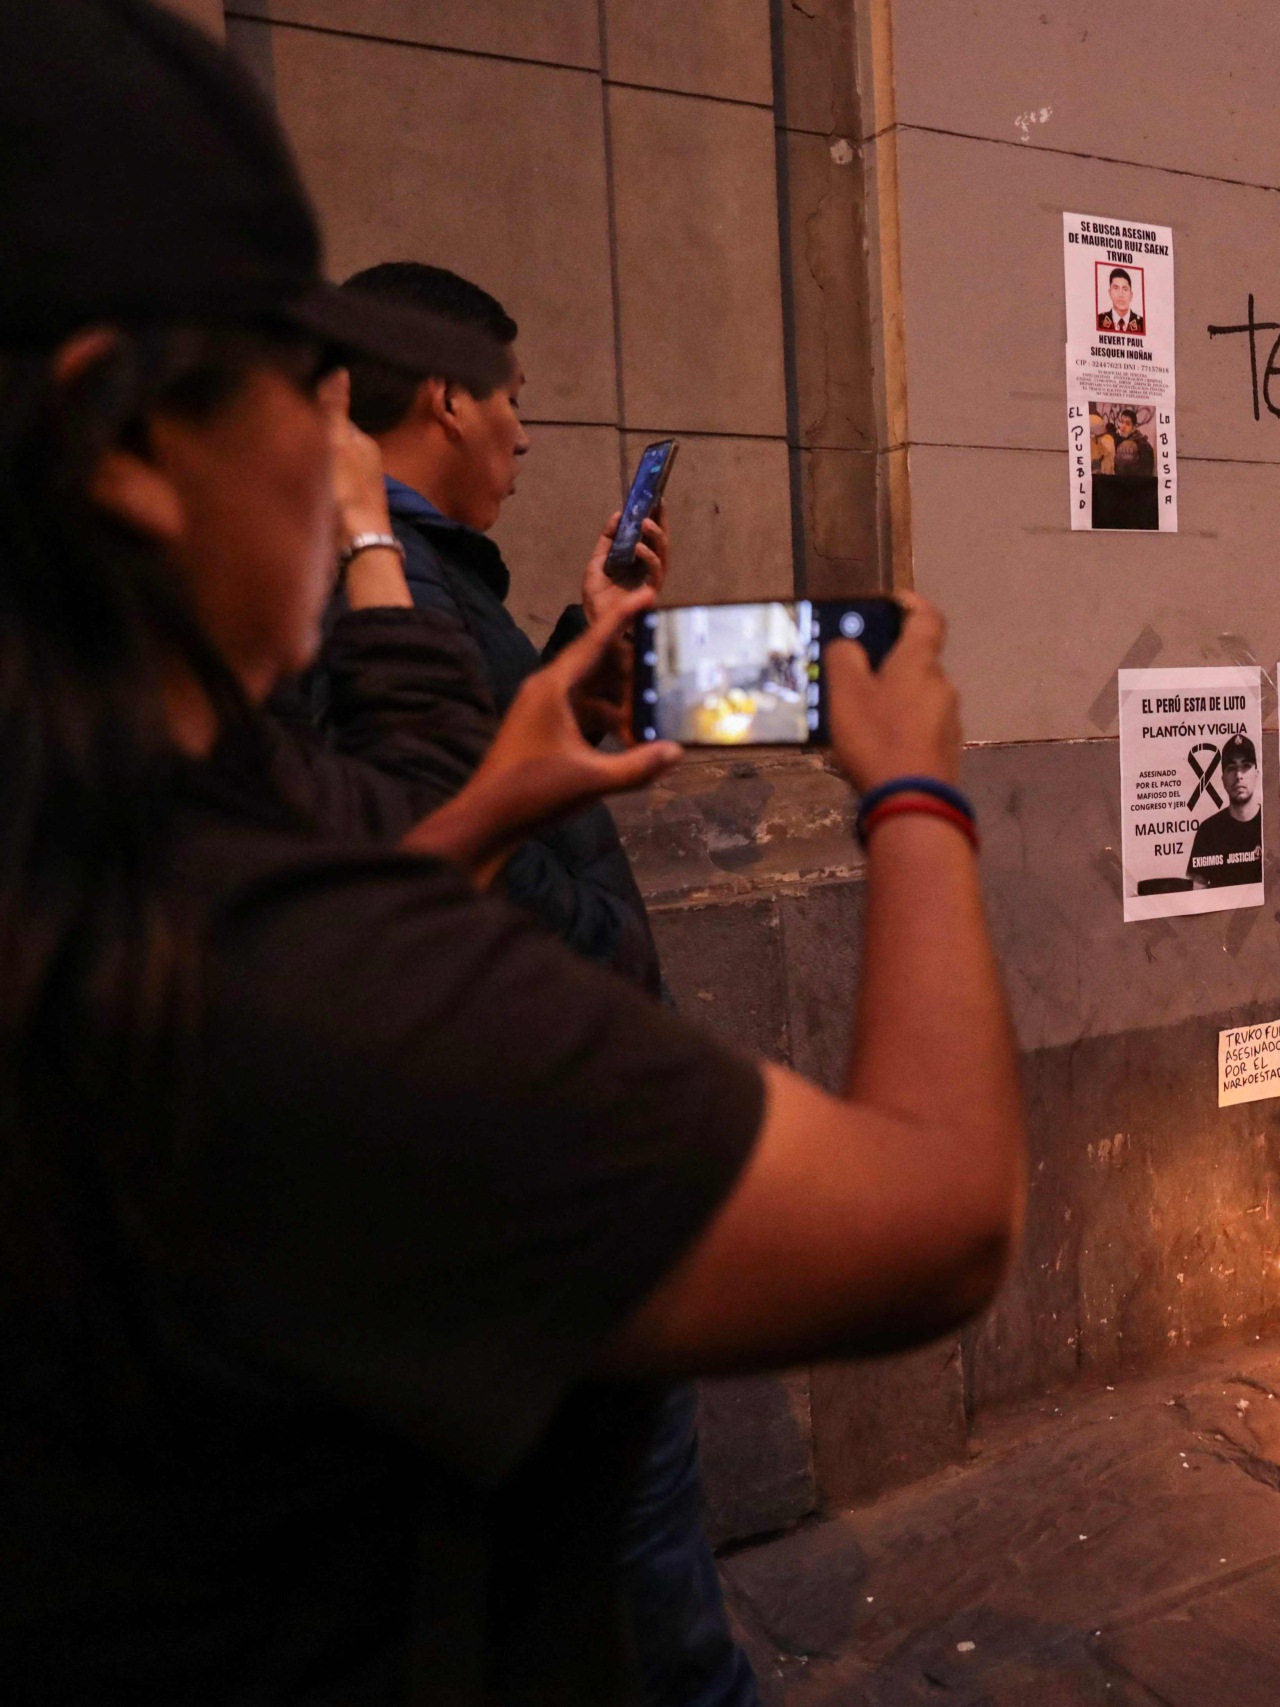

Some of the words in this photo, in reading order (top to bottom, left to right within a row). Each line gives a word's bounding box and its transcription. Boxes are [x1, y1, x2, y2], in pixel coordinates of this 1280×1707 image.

[1081, 221, 1091, 233] SE
[1093, 223, 1121, 238] BUSCA
[1122, 227, 1157, 242] ASESINO
[1068, 232, 1080, 244] DE
[1081, 234, 1123, 250] MAURICIO
[1124, 240, 1143, 253] RUIZ
[1144, 243, 1169, 256] SAENZ
[1106, 250, 1133, 264] TRVKO
[1098, 334, 1126, 348] HEVERT
[1126, 336, 1144, 348] PAUL
[1090, 346, 1125, 360] SIESQUEN
[1126, 349, 1153, 362] INOÑAN
[1069, 406, 1083, 418] EL
[1159, 413, 1170, 424] LO
[1142, 698, 1154, 714] EL
[1156, 694, 1181, 713] PERÚ
[1184, 696, 1206, 713] ESTA
[1209, 696, 1222, 711] DE
[1223, 695, 1246, 711] LUTO
[1142, 721, 1197, 739] PLANTÓN
[1198, 724, 1206, 736] Y
[1207, 722, 1247, 736] VIGILIA
[1139, 769, 1177, 778] ASESINADO
[1136, 781, 1150, 789] POR
[1151, 780, 1159, 788] EL
[1160, 779, 1182, 788] PACTO
[1137, 791, 1167, 800] MAFIOSO
[1168, 790, 1181, 799] DEL
[1130, 802, 1167, 812] CONGRESO
[1135, 819, 1200, 837] MAURICIO
[1154, 842, 1184, 857] RUIZ
[1192, 854, 1224, 868] EXIGIMOS
[1227, 851, 1255, 864] JUSTICIA
[1225, 1062, 1247, 1078] POR
[1253, 1057, 1268, 1071] EL
